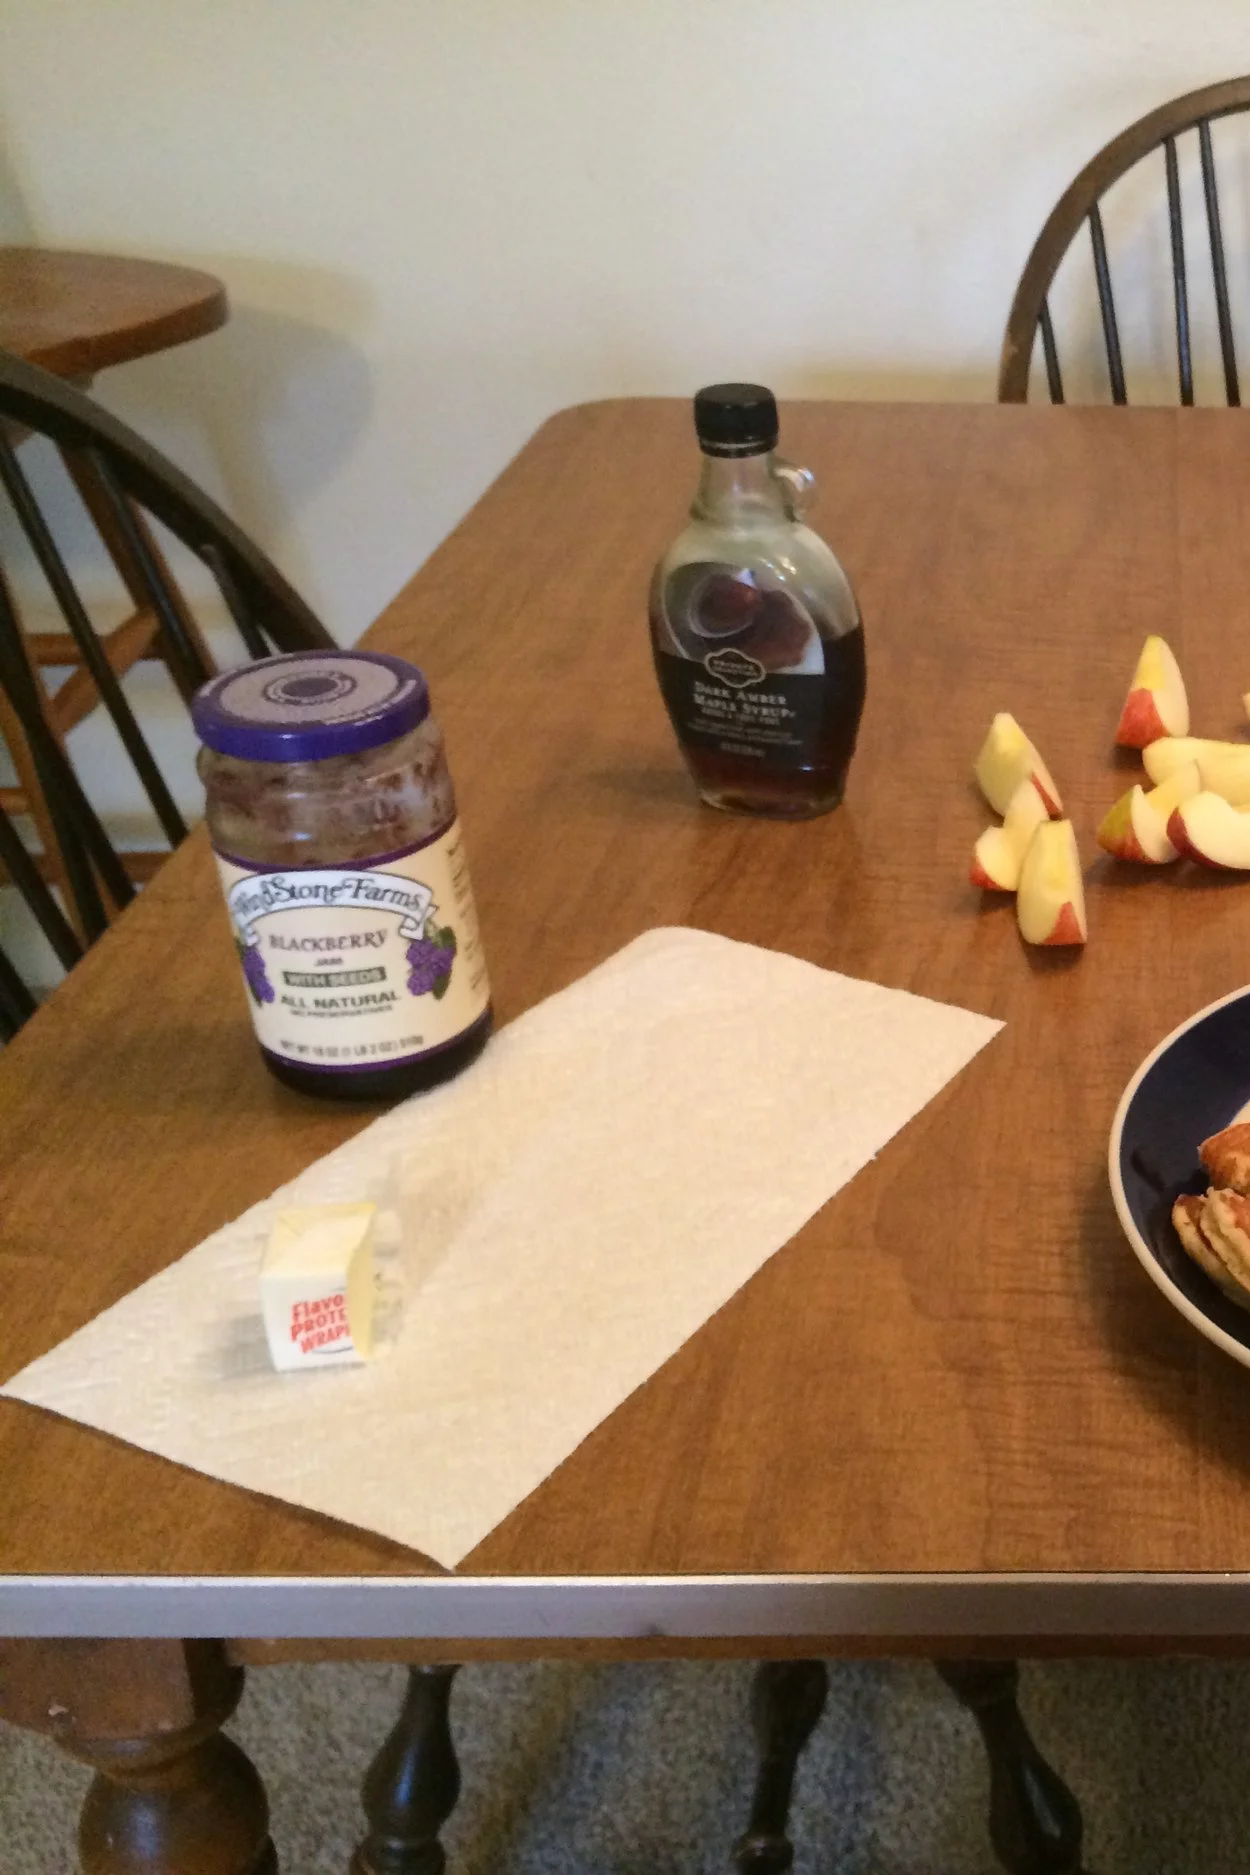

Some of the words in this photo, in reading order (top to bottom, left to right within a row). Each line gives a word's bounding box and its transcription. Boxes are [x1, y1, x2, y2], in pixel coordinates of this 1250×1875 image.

[268, 929, 389, 952] BLACKBERRY
[281, 994, 307, 1009] ALL
[313, 991, 399, 1008] NATURAL
